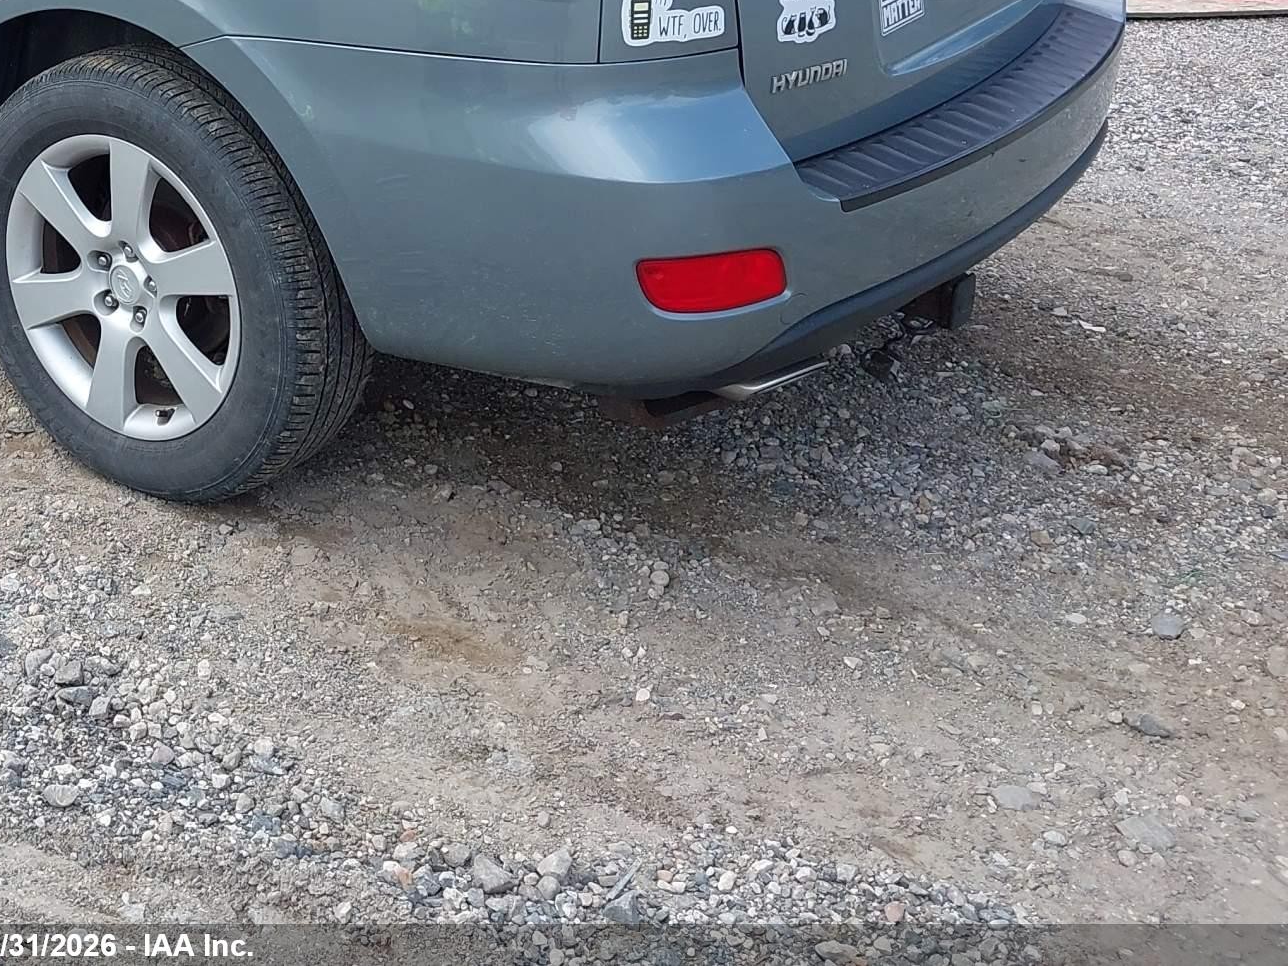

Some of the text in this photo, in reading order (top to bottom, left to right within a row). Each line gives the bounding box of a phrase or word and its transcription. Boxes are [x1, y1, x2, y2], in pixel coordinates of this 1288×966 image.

[658, 11, 722, 39] WTF, OVER.
[771, 58, 848, 94] HYUNDAI
